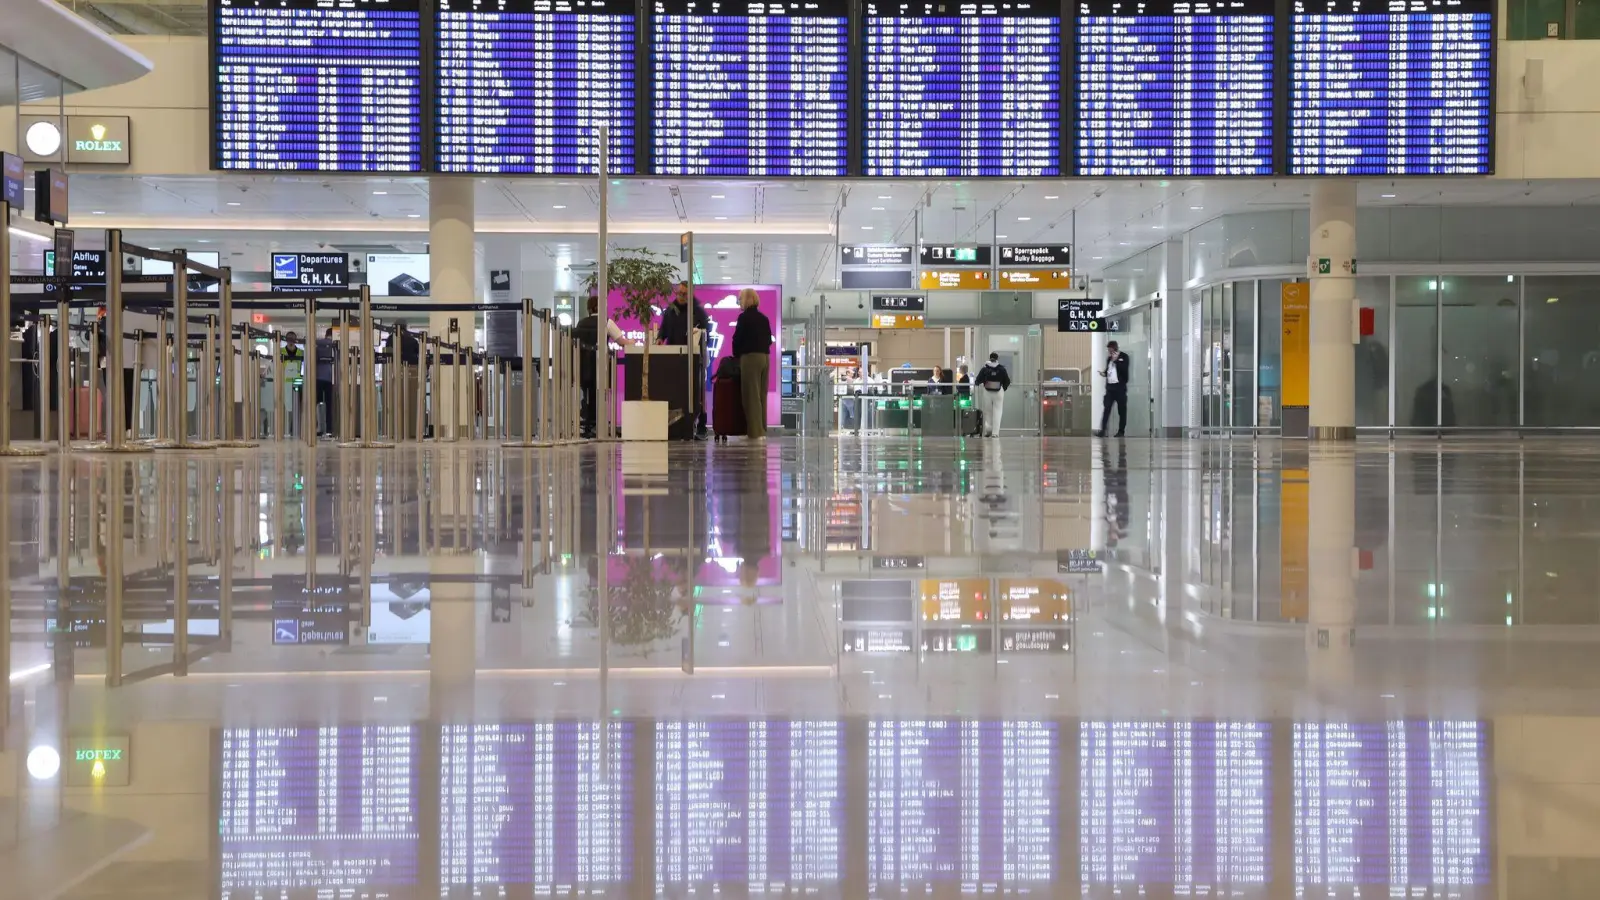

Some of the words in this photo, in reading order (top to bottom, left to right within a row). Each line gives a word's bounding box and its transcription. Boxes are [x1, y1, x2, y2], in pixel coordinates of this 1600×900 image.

[76, 141, 121, 150] ROLEX
[73, 252, 99, 262] Abflug
[300, 255, 343, 264] Departures
[301, 274, 310, 285] G,
[312, 274, 322, 285] H,
[324, 274, 333, 285] K,
[335, 274, 341, 284] L
[1070, 311, 1077, 319] G,
